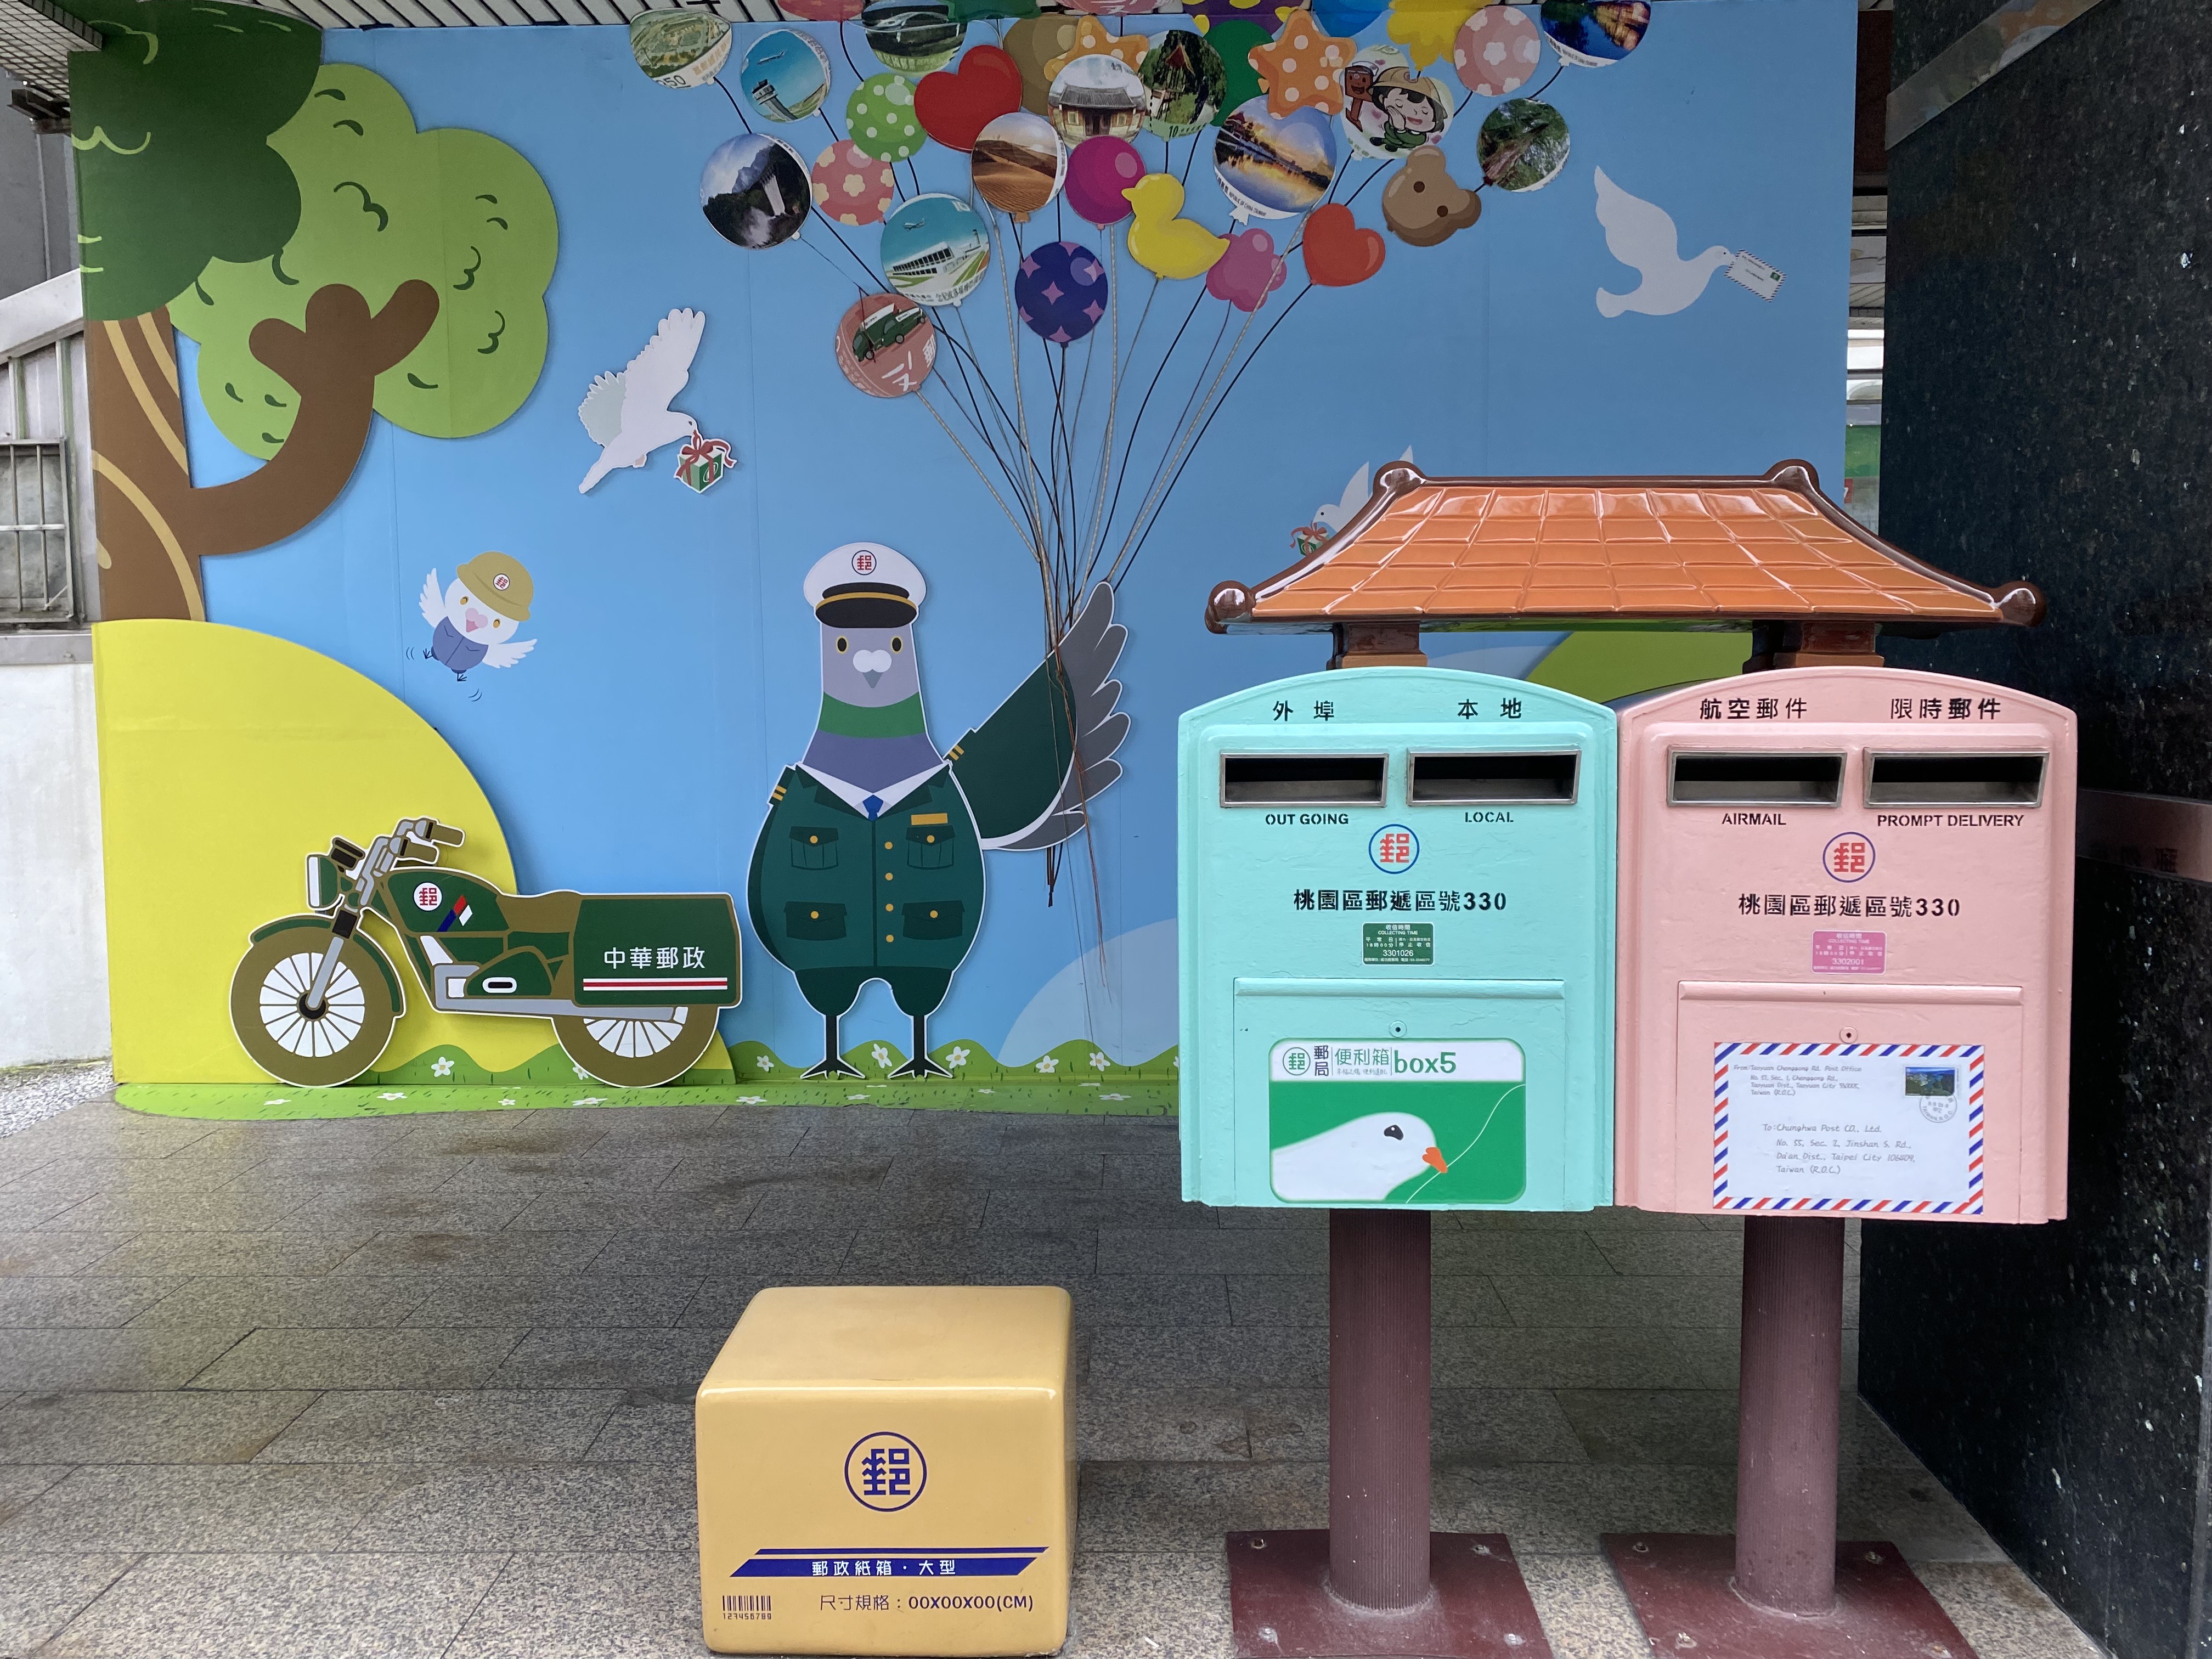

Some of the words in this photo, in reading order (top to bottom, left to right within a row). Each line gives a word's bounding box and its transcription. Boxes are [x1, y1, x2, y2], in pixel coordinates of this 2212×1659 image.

[856, 555, 872, 571] 郵
[495, 575, 509, 589] 郵
[1272, 700, 1335, 722] 外埠
[1457, 697, 1523, 720] 本地
[1699, 697, 1808, 720] 航空郵件
[1890, 697, 2001, 720] 限時郵件
[1265, 814, 1296, 826] OUT
[1299, 813, 1349, 825] GOING
[1464, 811, 1514, 823] LOCAL
[1721, 812, 1787, 826] AIRMAIL
[1877, 814, 1943, 827] PROMPT
[1947, 814, 2025, 827] DELIVERY
[1379, 833, 1410, 864] 郵
[1833, 842, 1865, 873] 郵
[419, 887, 438, 906] 郵
[1293, 889, 1507, 912] 桃園區郵遞區號330
[1737, 893, 1961, 917] 桃園區郵遞區號330
[603, 946, 706, 970] 中華郵政
[1288, 1052, 1306, 1070] 郵
[1313, 1044, 1329, 1077] 郵局
[1334, 1047, 1390, 1066] 便利箱
[1394, 1051, 1457, 1074] box5
[1821, 1124, 1839, 1132] Post
[1831, 1153, 1858, 1161] Taipei
[1863, 1154, 1882, 1162] City
[1776, 1165, 1804, 1173] Taiwan
[861, 1447, 911, 1497] 郵
